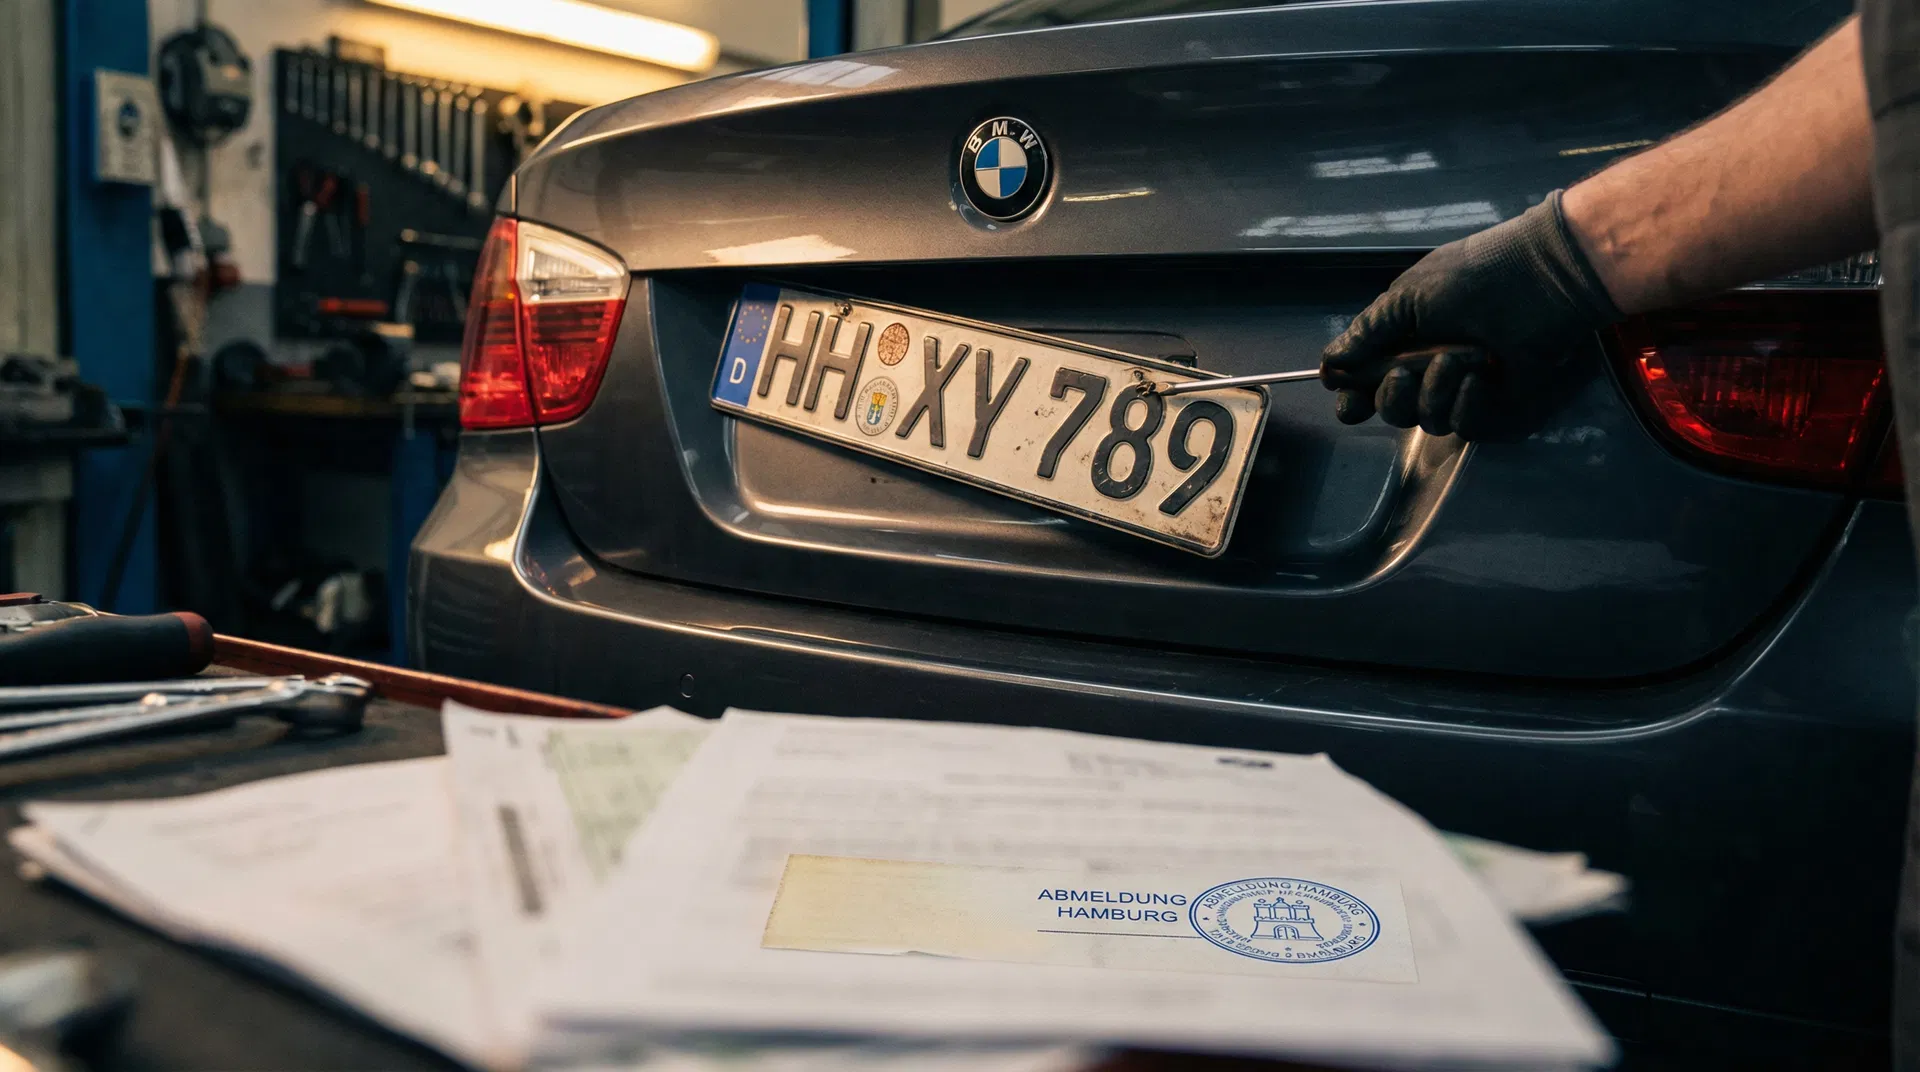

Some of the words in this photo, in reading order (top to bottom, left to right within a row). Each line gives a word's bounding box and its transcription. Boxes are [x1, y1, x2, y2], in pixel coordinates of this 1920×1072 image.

[967, 120, 1038, 154] BMW
[729, 357, 747, 384] D
[757, 304, 873, 421] HH
[895, 335, 1030, 460] XY
[1036, 366, 1236, 517] 789
[1038, 888, 1187, 906] ABMELDUNG
[1057, 906, 1178, 923] HAMBURG
